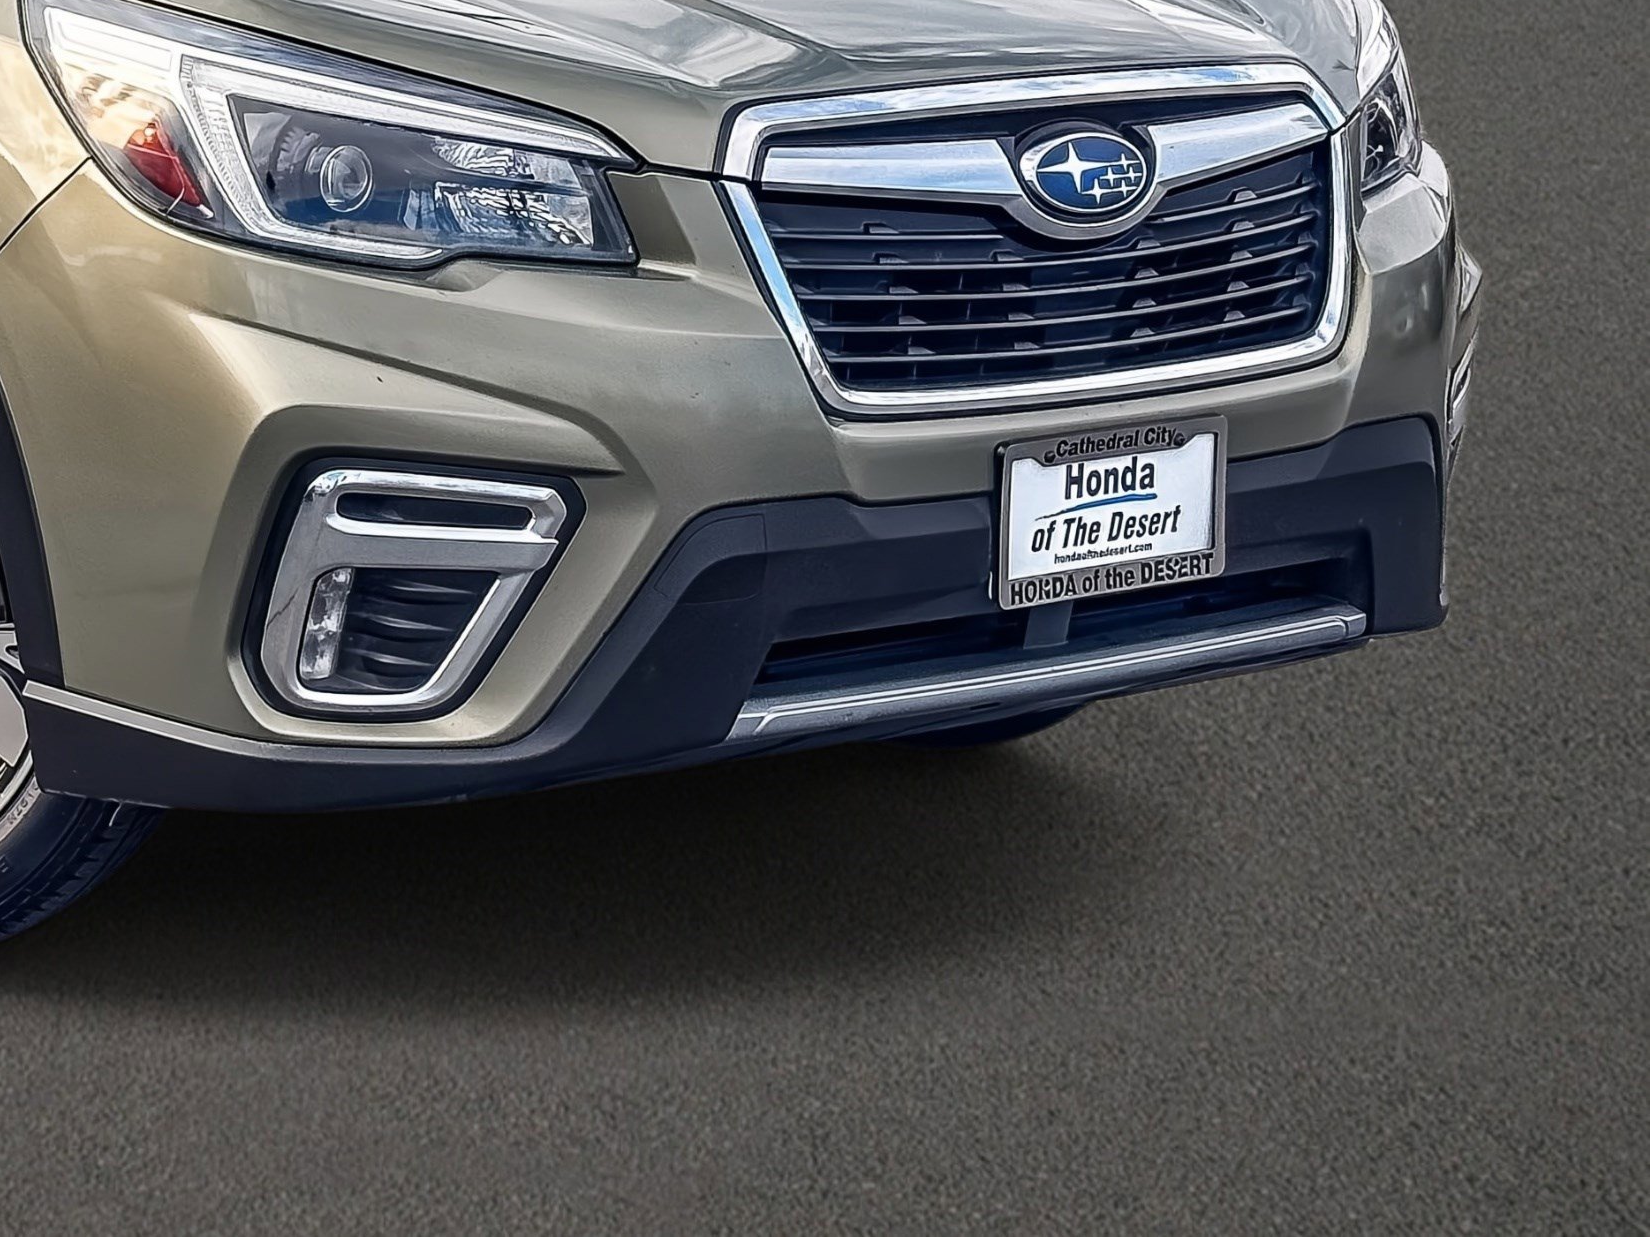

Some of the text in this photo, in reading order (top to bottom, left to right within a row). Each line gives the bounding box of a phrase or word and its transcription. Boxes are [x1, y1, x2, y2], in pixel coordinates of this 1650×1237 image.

[1056, 426, 1177, 458] Cathedral City
[1064, 455, 1156, 500] Honda
[1031, 504, 1182, 553] of The Desert
[1010, 552, 1215, 606] HONDA of the DESERT
